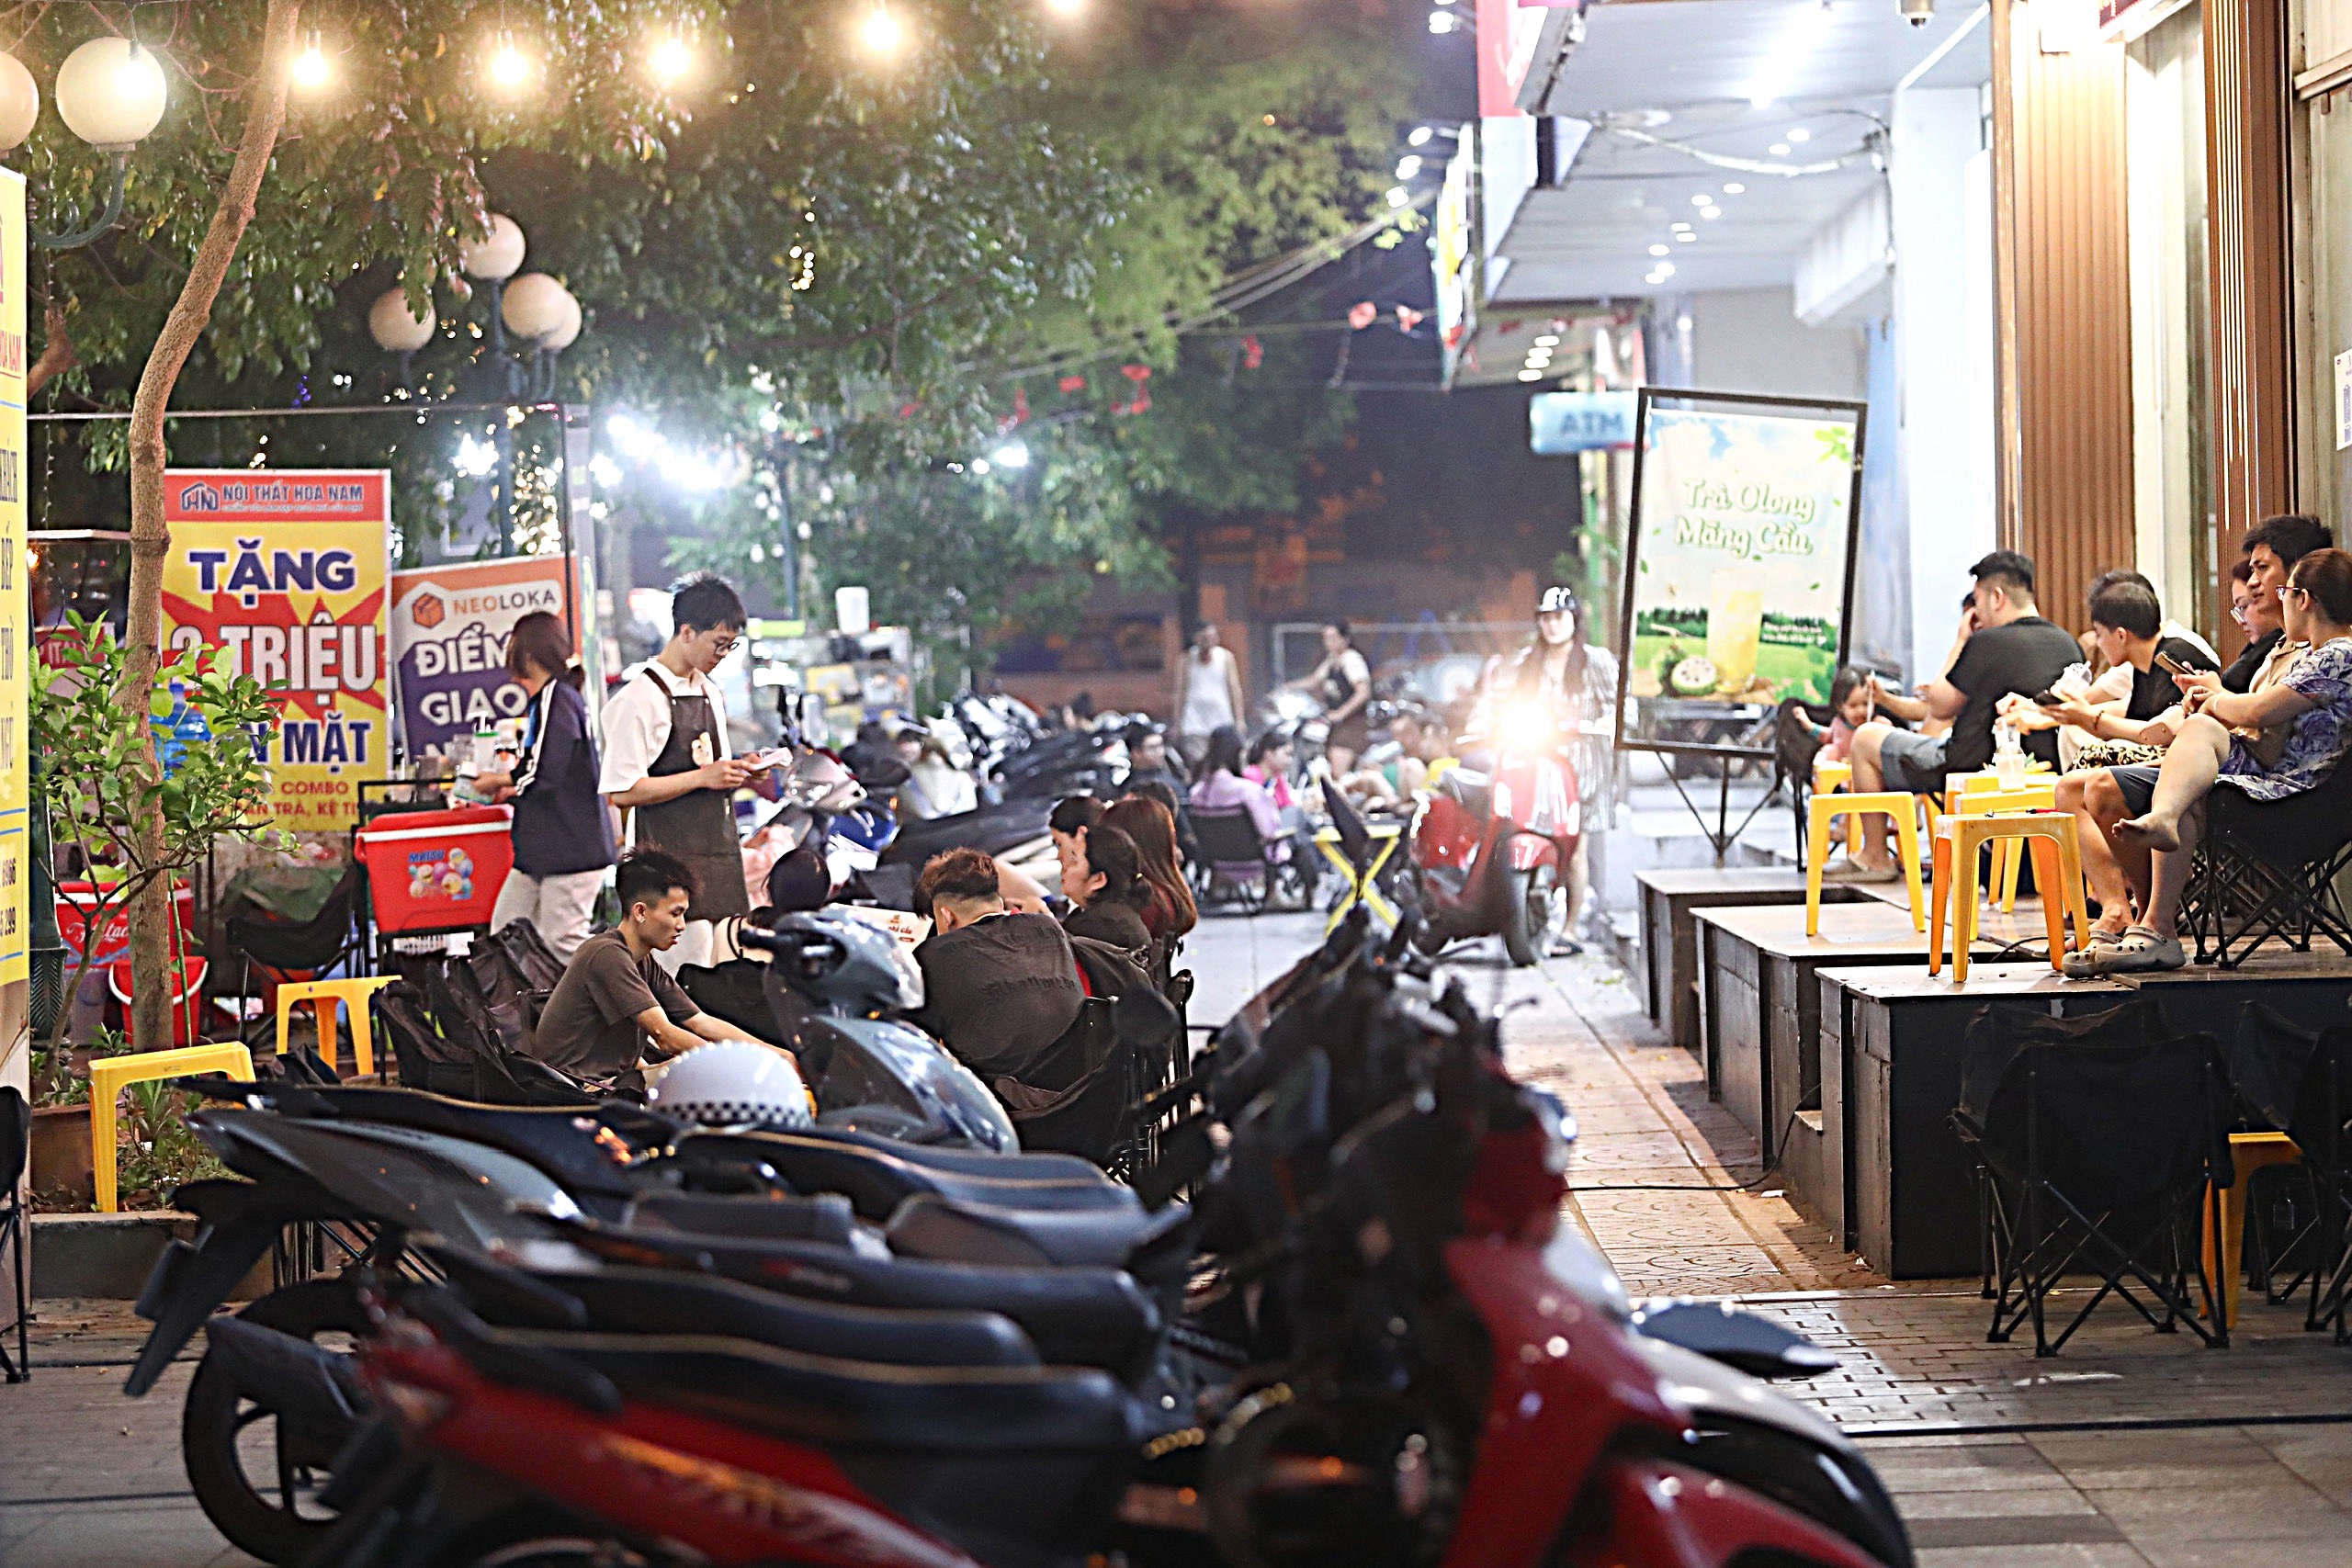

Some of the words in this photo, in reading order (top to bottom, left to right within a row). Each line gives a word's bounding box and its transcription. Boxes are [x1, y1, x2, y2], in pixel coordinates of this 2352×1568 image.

[1560, 411, 1624, 435] ATM
[223, 481, 249, 502] NỘI
[254, 479, 291, 502] THẤT
[294, 484, 323, 502] HOA
[328, 484, 364, 502] NAM
[1683, 479, 1733, 510] Trà
[1736, 483, 1815, 525] Olong
[189, 538, 356, 605] TẶNG
[453, 589, 556, 616] NEOLOKA
[220, 611, 378, 705] TRIỆU
[420, 683, 528, 726] GIAO
[284, 711, 370, 773] MẶT
[280, 781, 349, 795] COMBO
